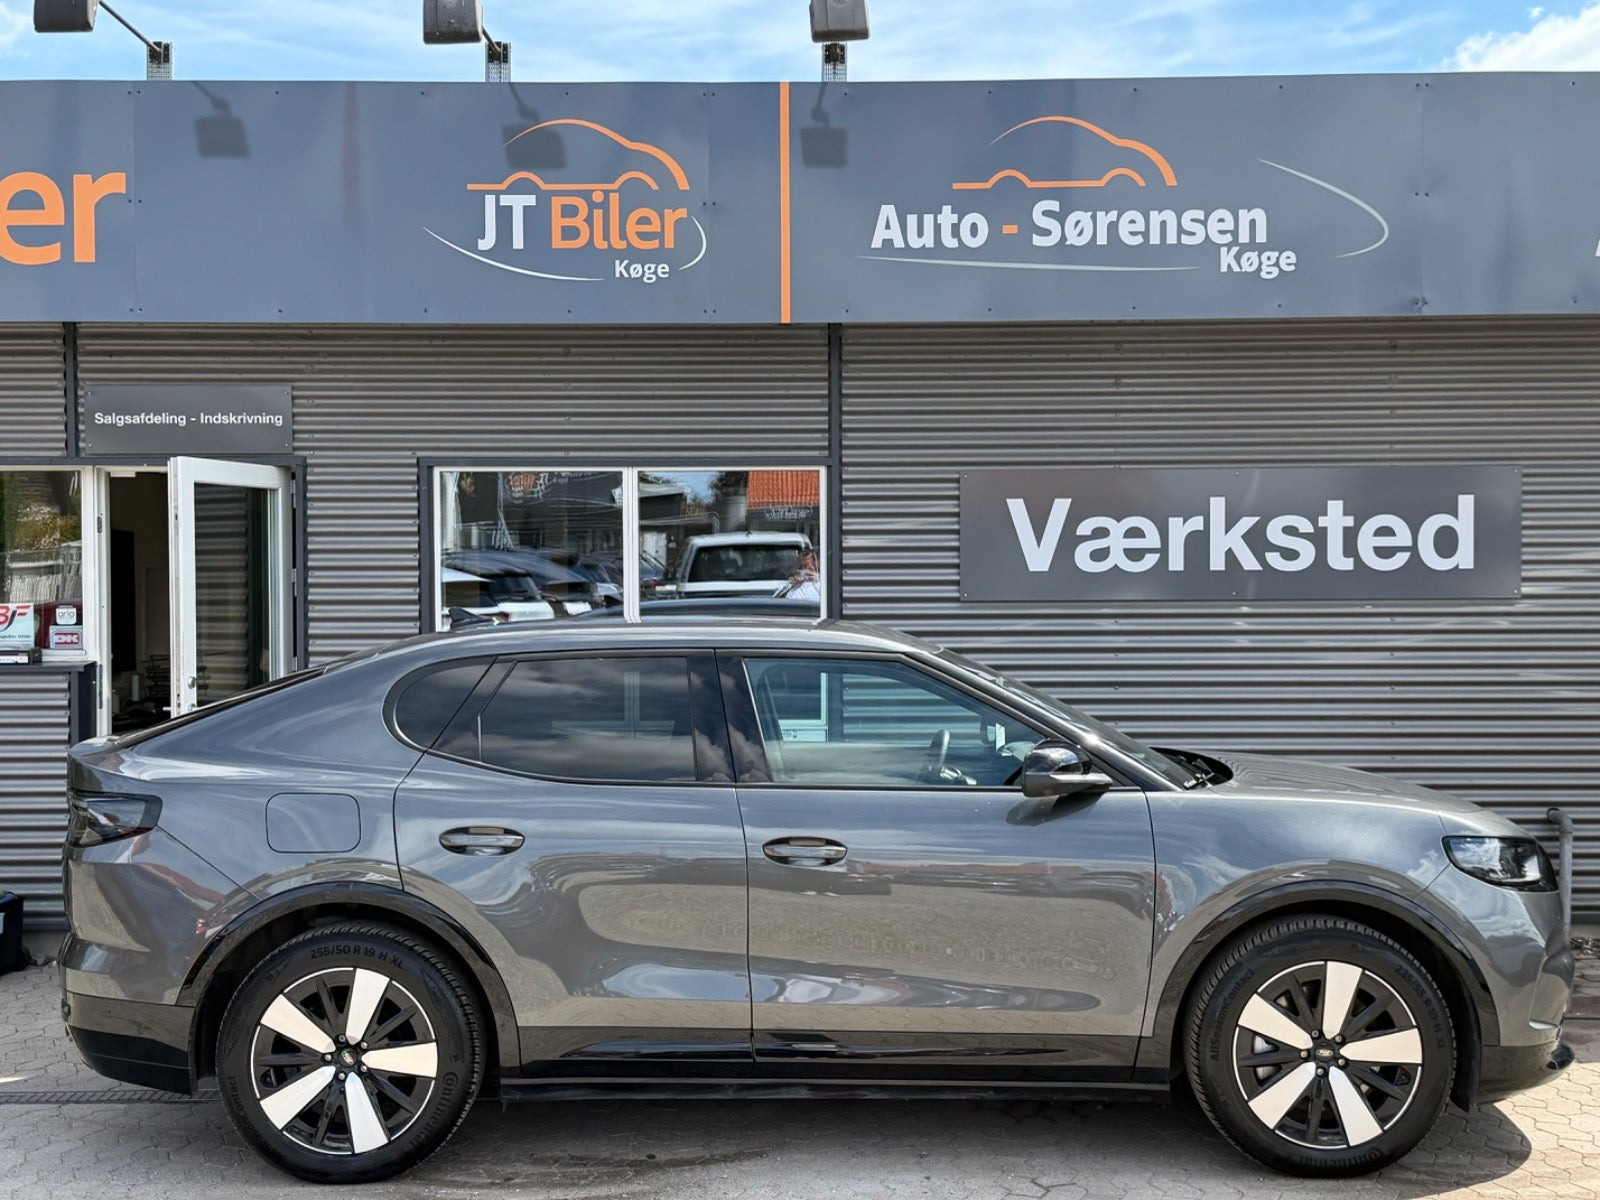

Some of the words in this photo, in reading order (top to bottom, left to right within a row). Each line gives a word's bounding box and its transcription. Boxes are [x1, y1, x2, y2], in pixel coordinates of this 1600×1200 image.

[477, 194, 537, 251] JT
[550, 190, 689, 250] Biler
[870, 204, 989, 249] Auto
[1031, 199, 1268, 247] Sørensen
[614, 259, 670, 283] Køge
[1219, 246, 1298, 280] Køge
[94, 412, 187, 427] Salgsafdeling
[200, 411, 284, 427] Indskrivning
[1005, 494, 1476, 574] Værksted
[310, 944, 351, 959] 255/50
[352, 945, 361, 955] R
[364, 947, 376, 957] 19
[378, 951, 388, 961] H
[390, 955, 403, 969] XL
[1394, 964, 1426, 998] 235/55
[1428, 1009, 1438, 1020] 19
